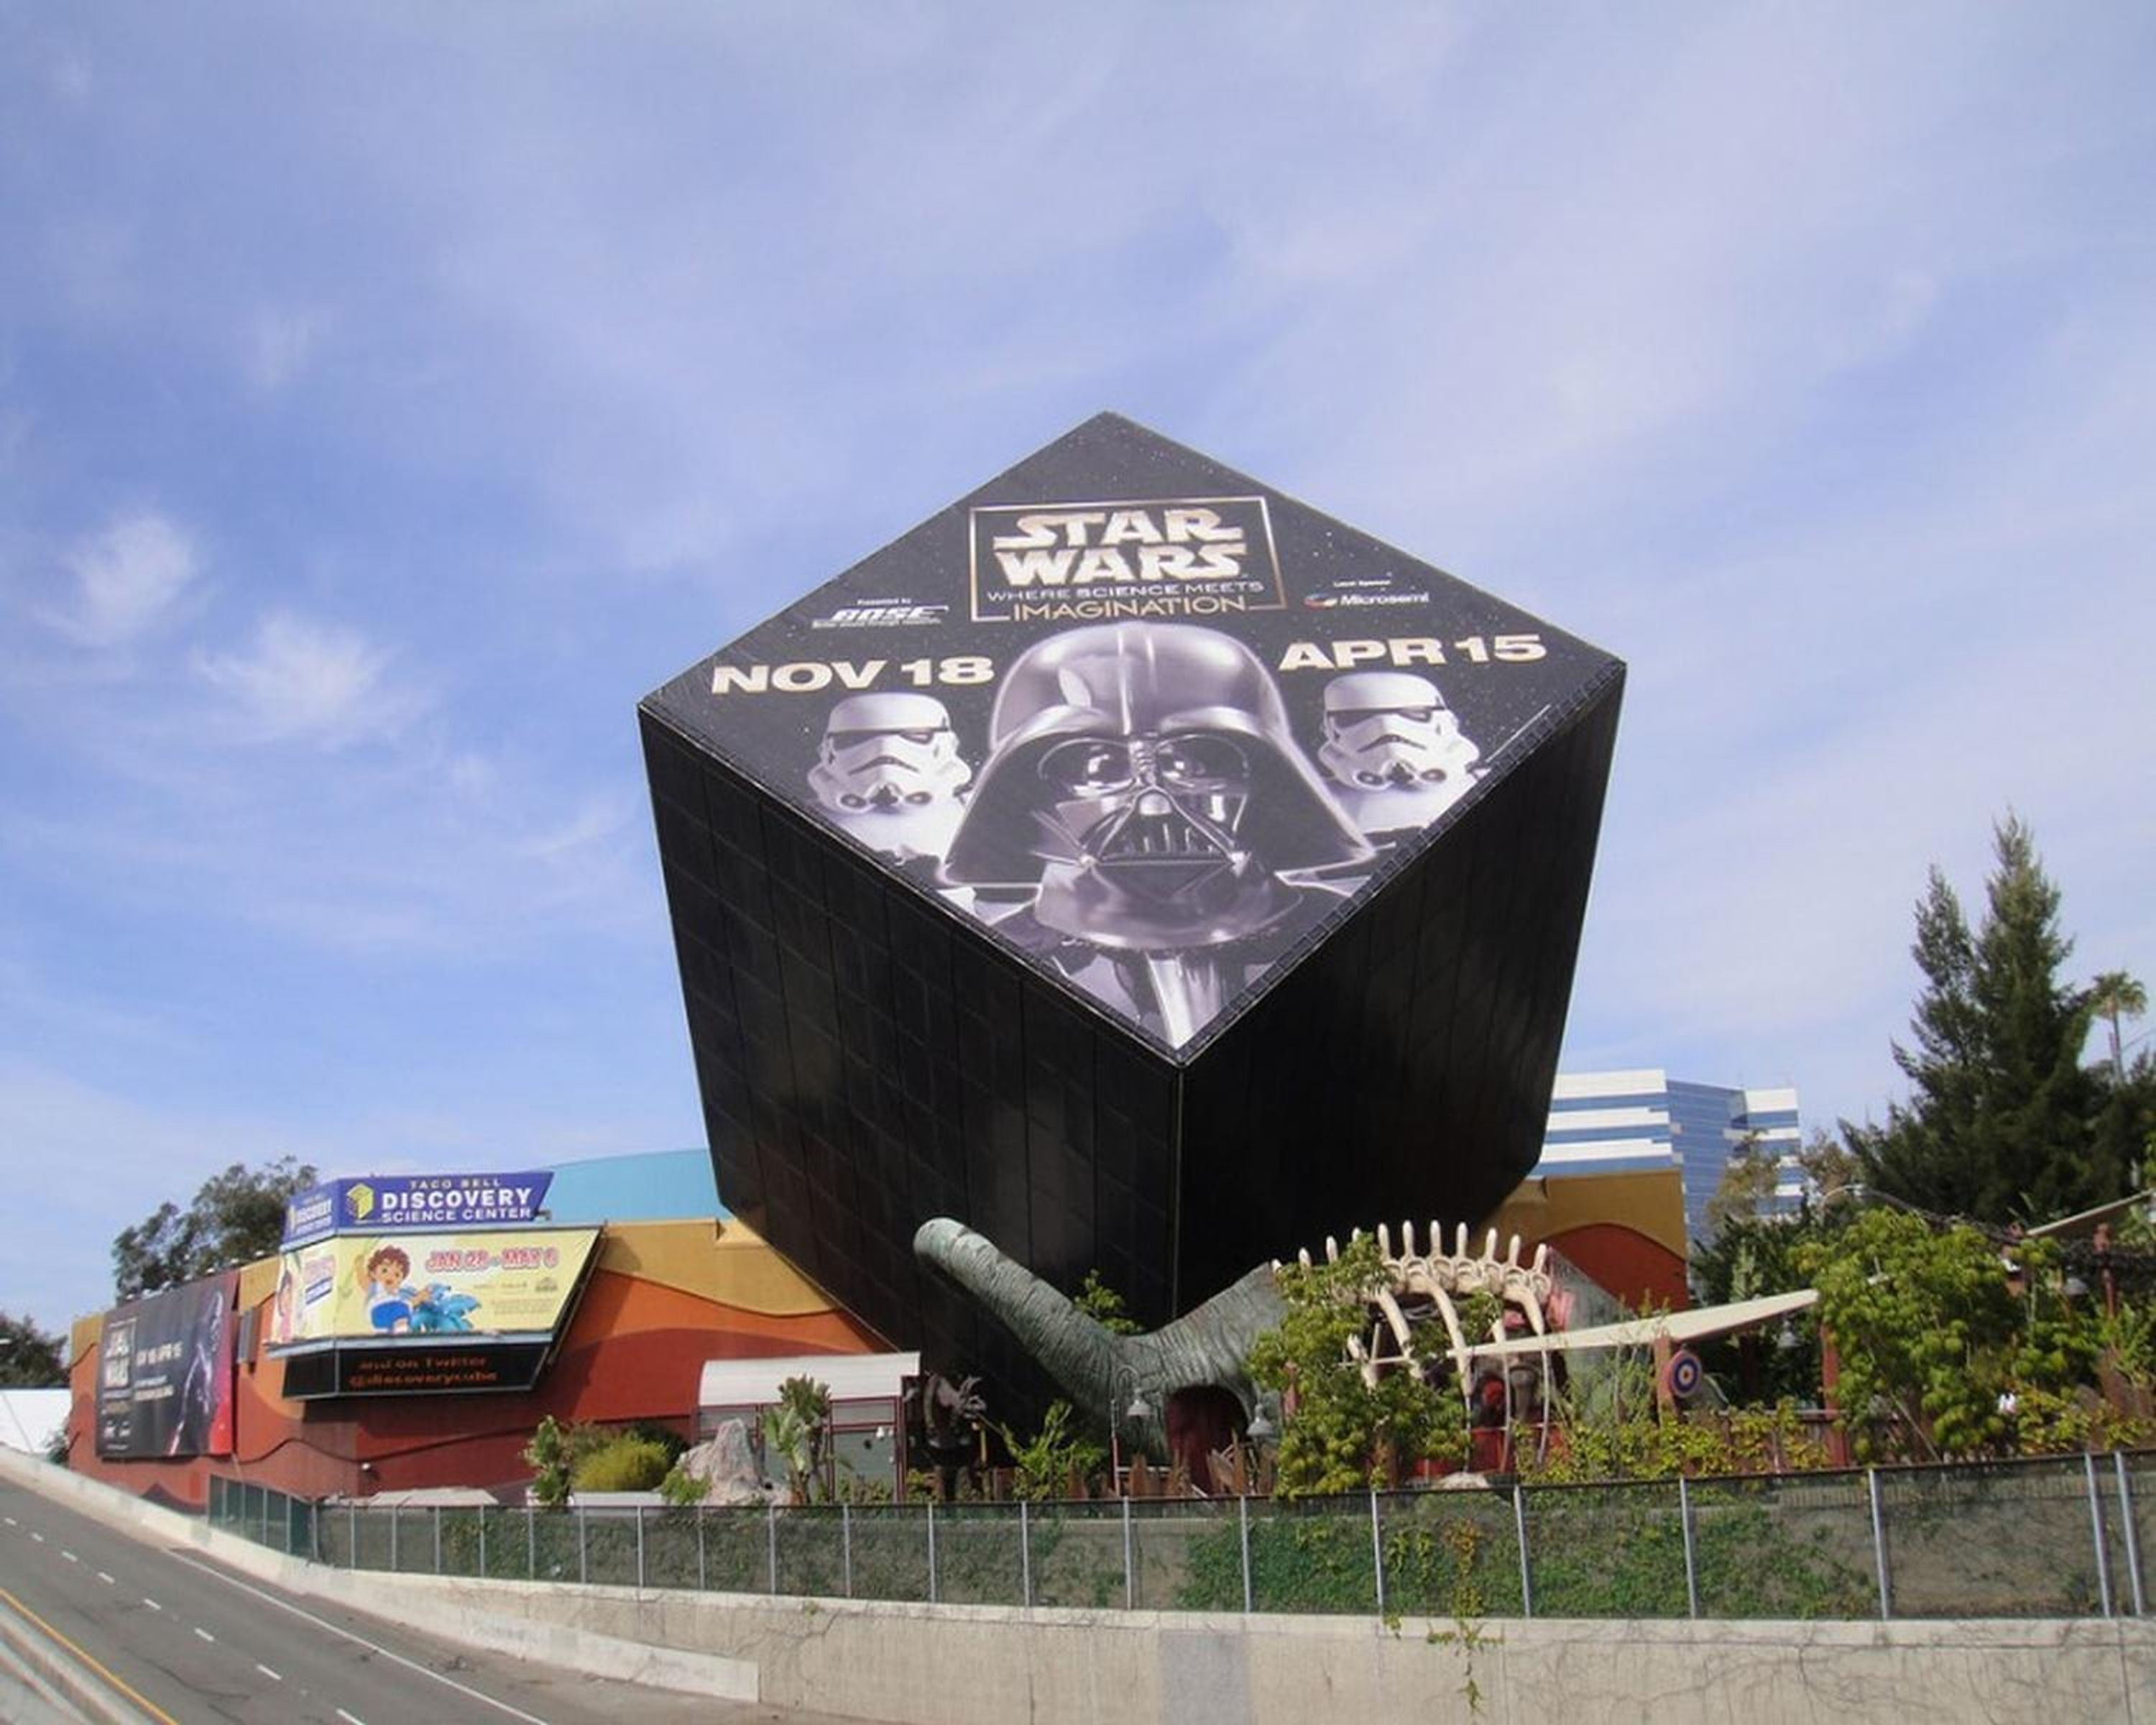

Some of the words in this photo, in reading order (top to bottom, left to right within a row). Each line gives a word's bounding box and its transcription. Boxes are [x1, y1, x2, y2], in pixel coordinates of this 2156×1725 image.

[993, 508, 1243, 549] STAR
[993, 542, 1247, 586] WARS
[987, 588, 1071, 602] WHERE
[1075, 584, 1179, 598] SCIENCE
[1184, 581, 1265, 594] MEETS
[1013, 596, 1247, 622] IMAGINATION
[1279, 637, 1447, 671] APR
[1454, 633, 1547, 663] 15
[711, 660, 886, 694] NOV
[901, 656, 995, 686] 18
[410, 1179, 452, 1190] TACO
[461, 1178, 502, 1187] BELL
[382, 1187, 533, 1210] DISCOVERY
[382, 1209, 457, 1223] SCIENCE
[461, 1207, 531, 1220] CENTER
